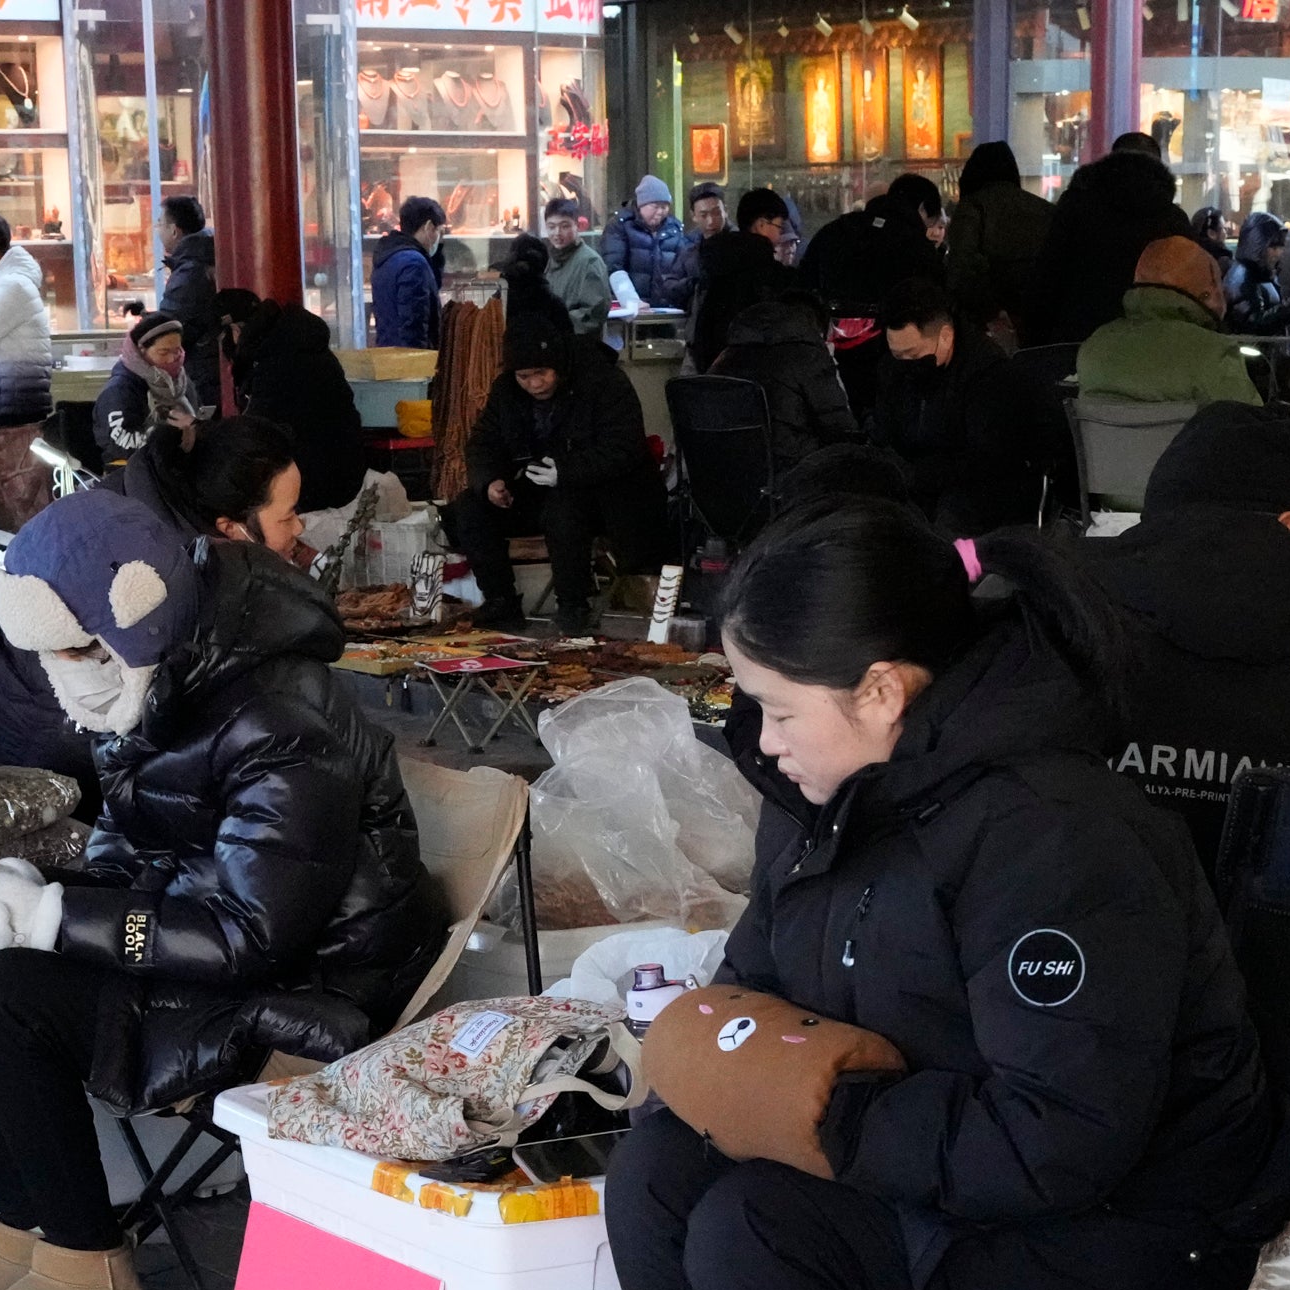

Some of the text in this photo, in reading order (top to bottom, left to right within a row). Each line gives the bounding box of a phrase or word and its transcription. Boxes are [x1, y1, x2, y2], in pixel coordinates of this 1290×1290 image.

[124, 914, 137, 955] COOL
[134, 914, 147, 963] BLACK
[1017, 961, 1043, 976] FU
